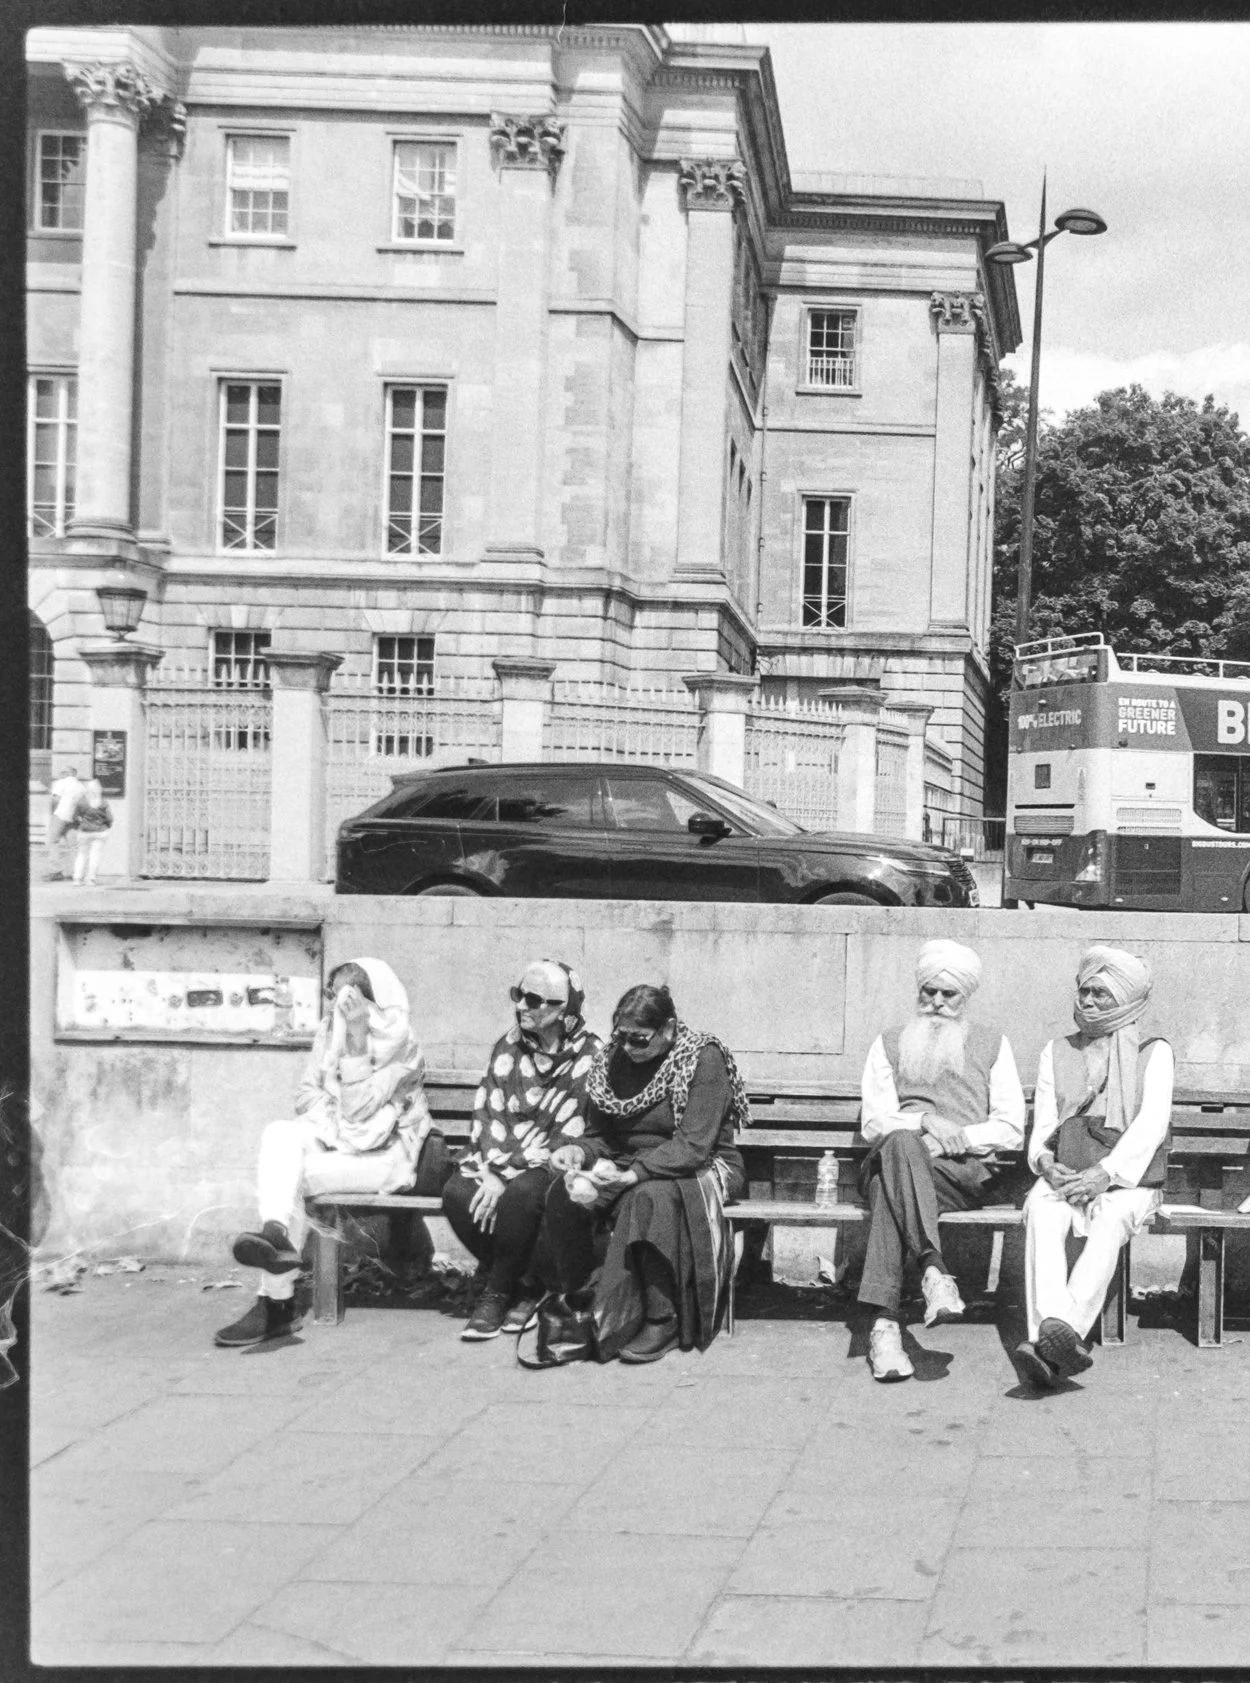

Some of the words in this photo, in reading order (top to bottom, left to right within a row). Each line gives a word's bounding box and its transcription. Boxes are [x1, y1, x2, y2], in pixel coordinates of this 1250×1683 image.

[1119, 698, 1130, 706] EN
[1132, 699, 1157, 708] ROUTE
[1158, 699, 1169, 708] TO
[1169, 700, 1176, 708] A
[1039, 710, 1081, 727] ELECTRIC
[1118, 706, 1176, 720] GREENER
[1118, 719, 1176, 735] FUTURE
